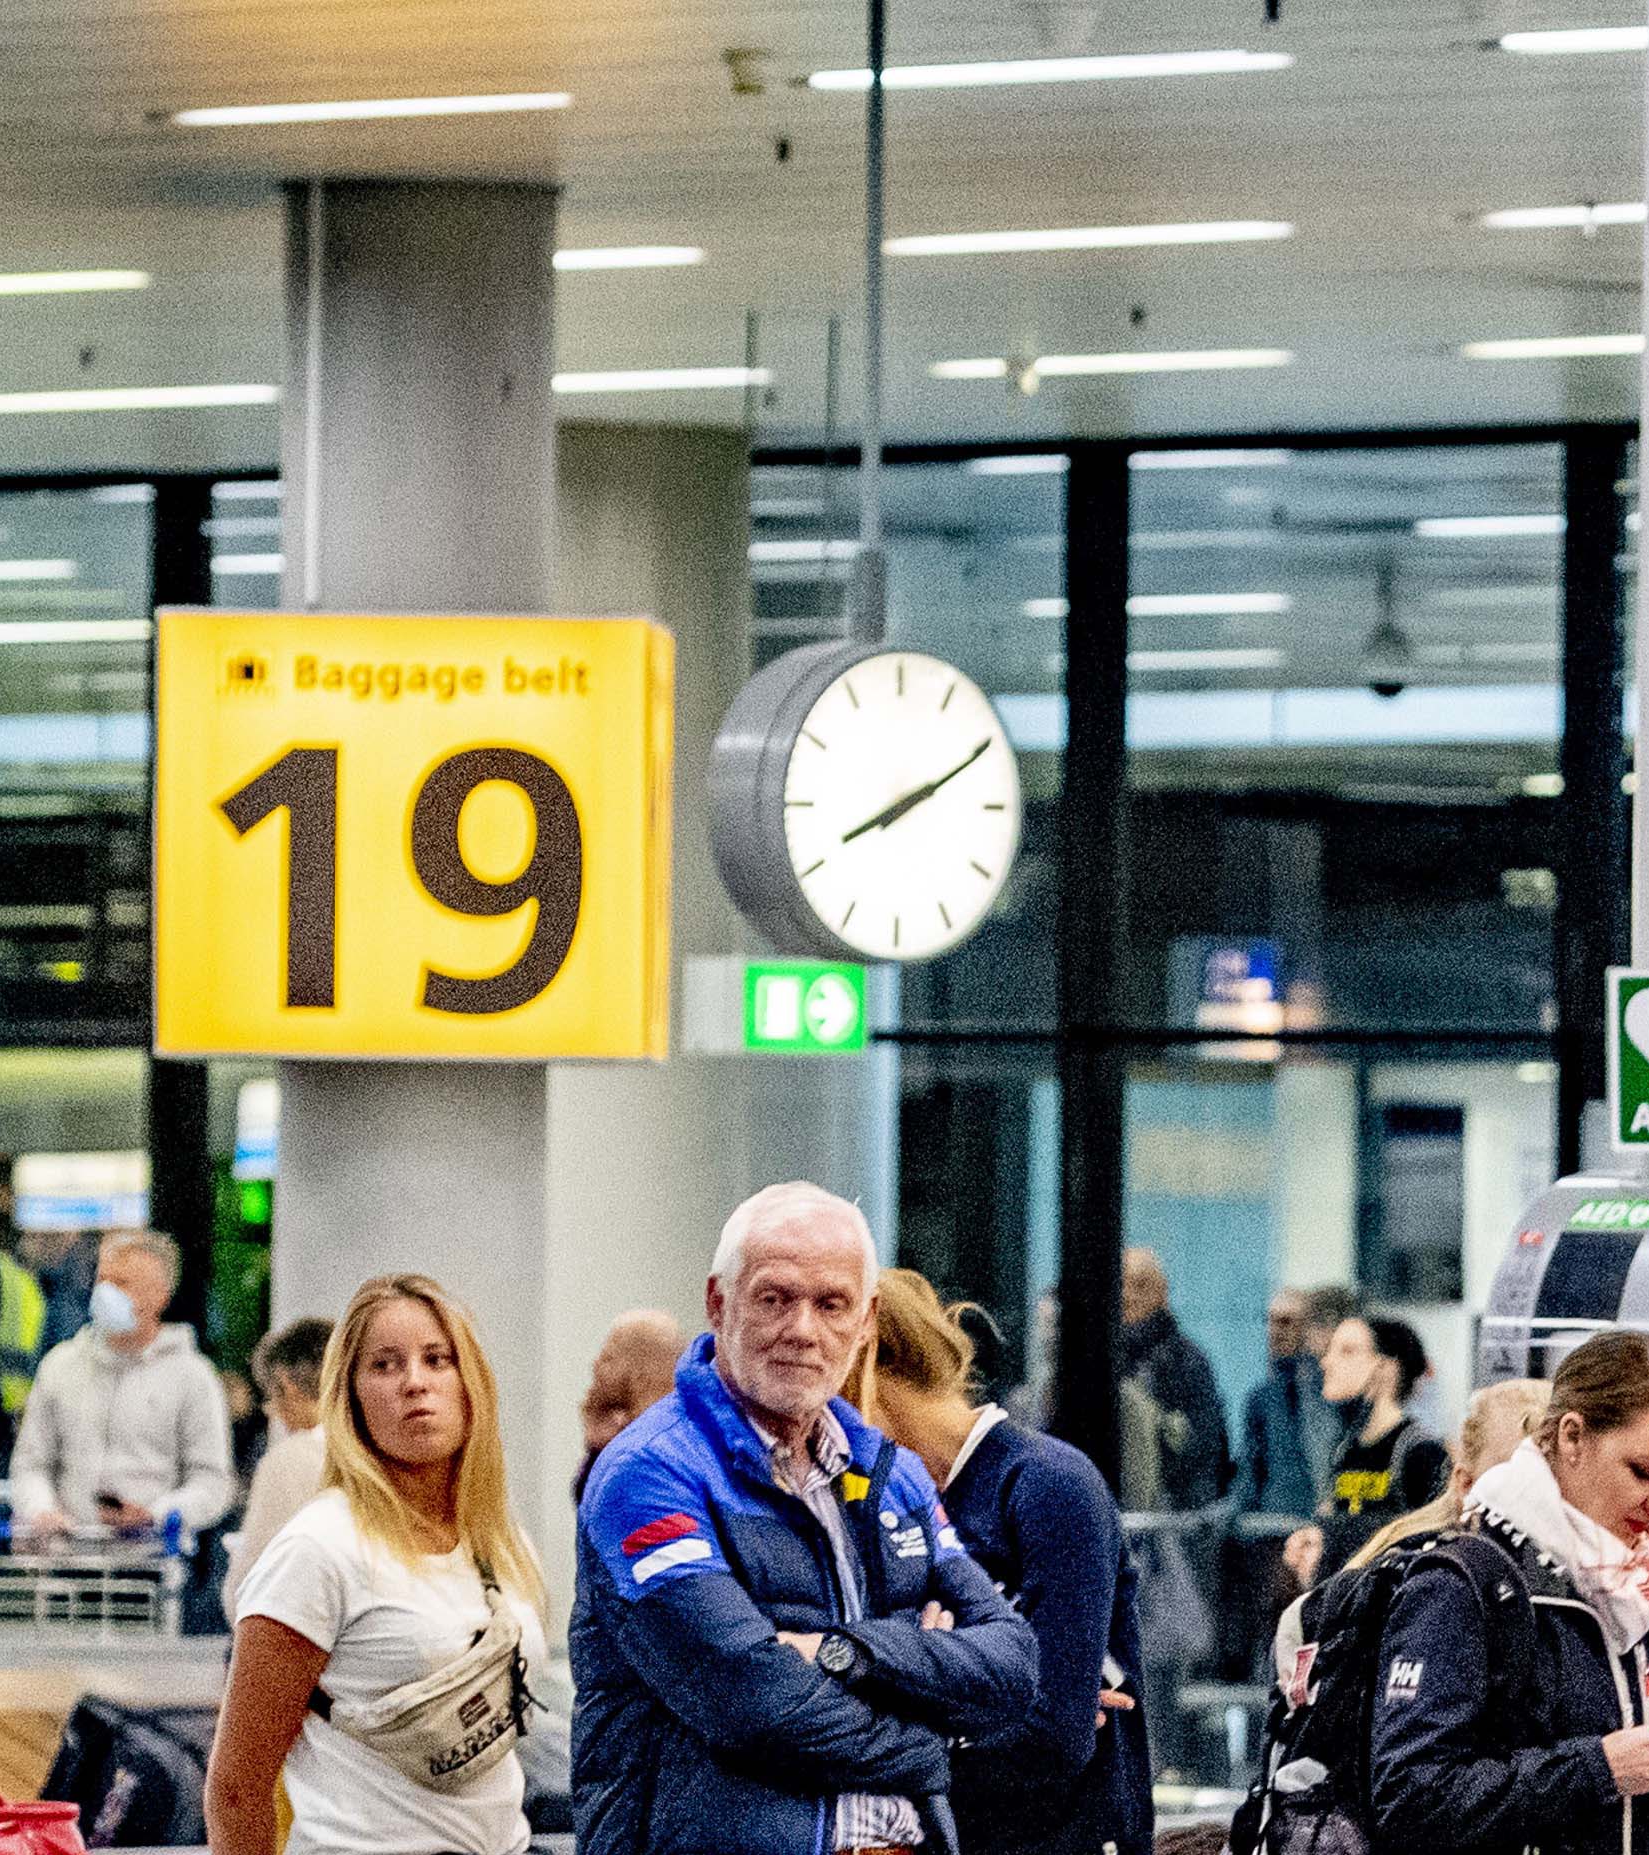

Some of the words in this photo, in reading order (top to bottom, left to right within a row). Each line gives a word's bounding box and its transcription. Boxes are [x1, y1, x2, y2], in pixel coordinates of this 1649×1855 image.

[293, 656, 485, 700] Baggage
[505, 656, 591, 699] belt
[216, 744, 585, 1016] 19
